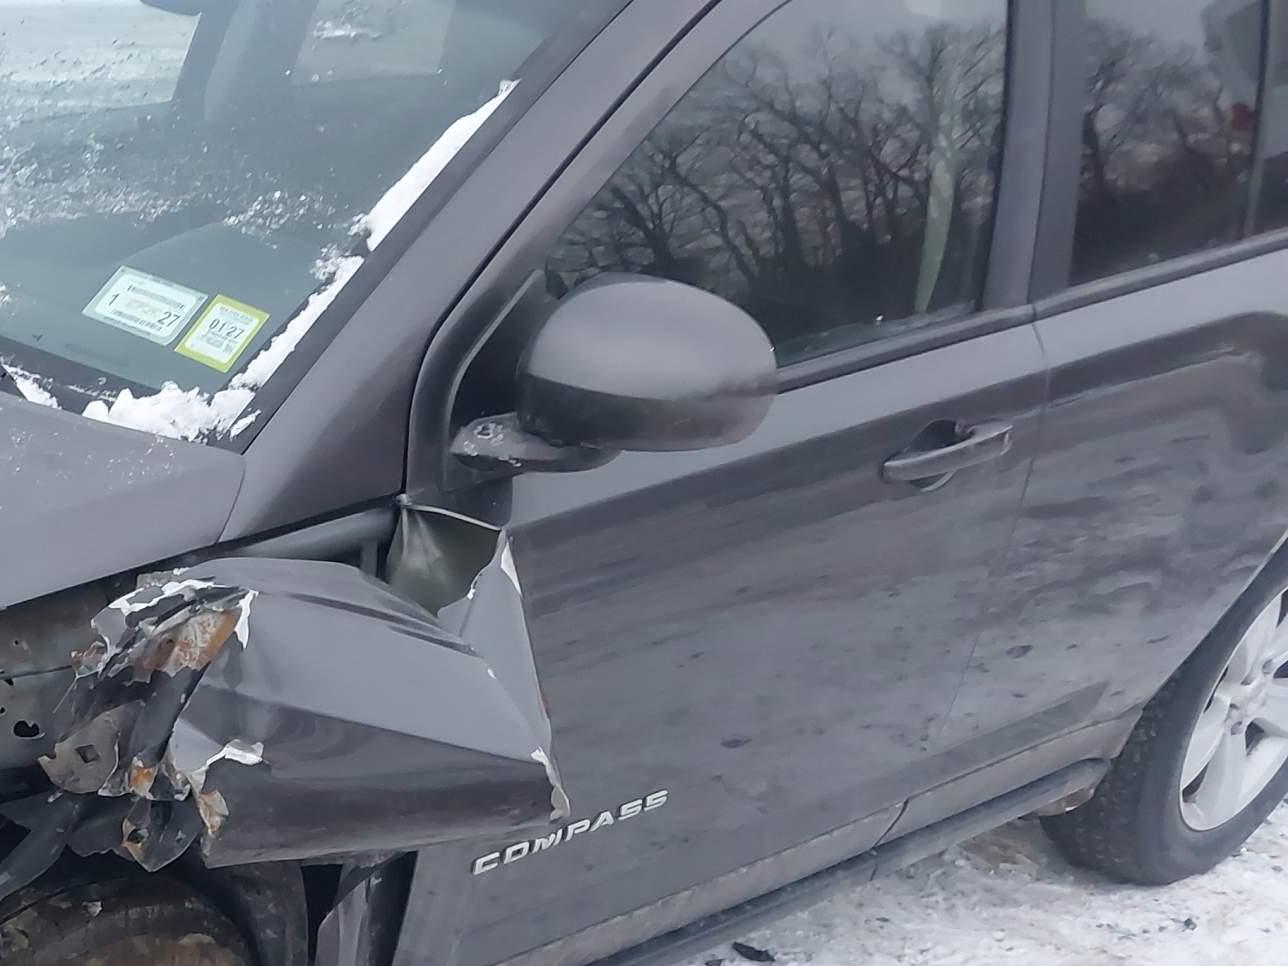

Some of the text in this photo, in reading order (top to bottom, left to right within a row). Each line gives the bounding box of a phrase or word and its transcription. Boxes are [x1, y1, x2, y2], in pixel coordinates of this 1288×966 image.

[108, 292, 120, 305] 1
[157, 311, 181, 328] 27
[471, 788, 669, 875] COMPASS
